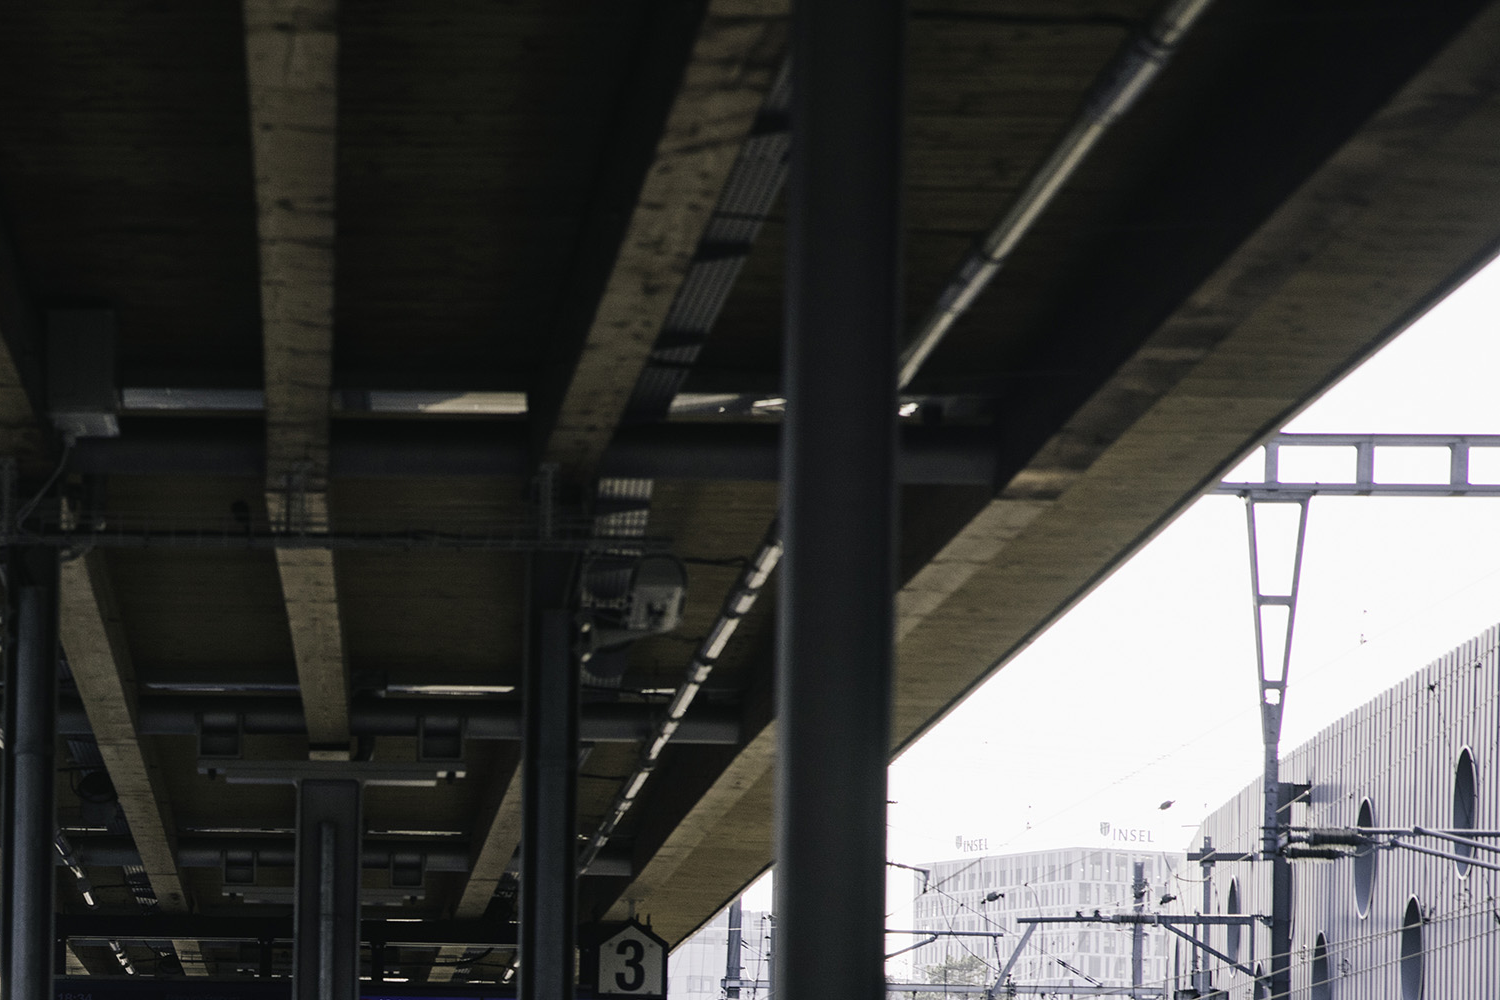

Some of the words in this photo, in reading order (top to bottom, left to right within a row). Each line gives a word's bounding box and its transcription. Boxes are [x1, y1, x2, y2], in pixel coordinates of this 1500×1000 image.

[1112, 828, 1154, 843] INSEL
[963, 838, 989, 852] INSEL
[615, 939, 645, 991] 3
